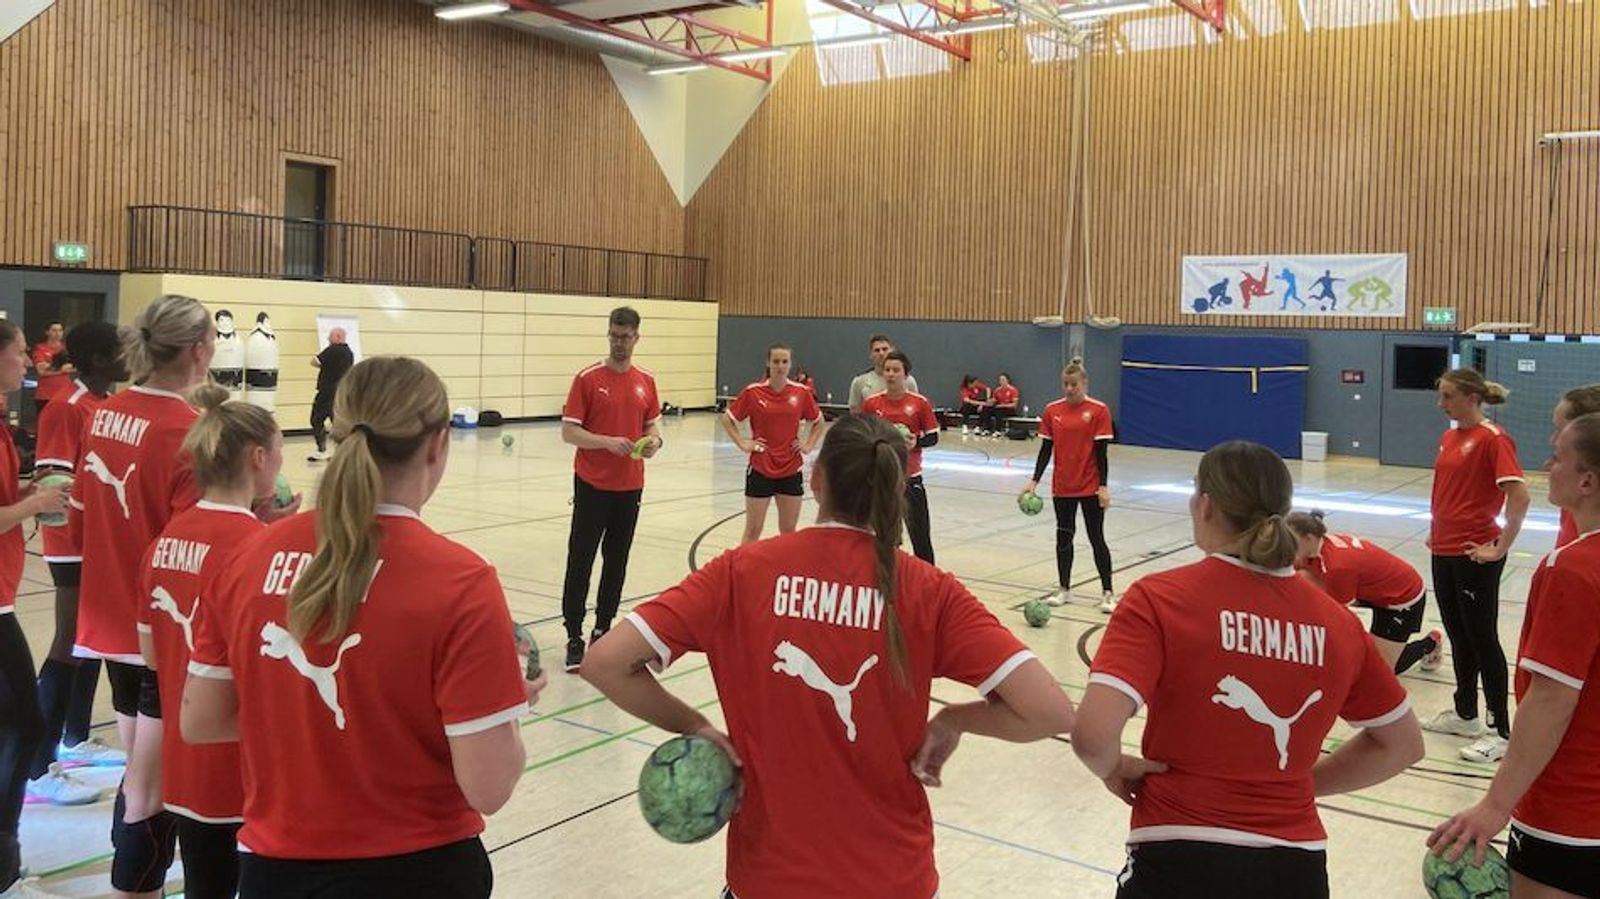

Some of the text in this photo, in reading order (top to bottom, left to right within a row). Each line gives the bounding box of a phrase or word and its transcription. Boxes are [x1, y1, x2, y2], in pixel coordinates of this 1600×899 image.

[151, 537, 211, 576] GERMANY
[773, 575, 885, 631] GERMANY
[1219, 609, 1326, 667] GERMANY
